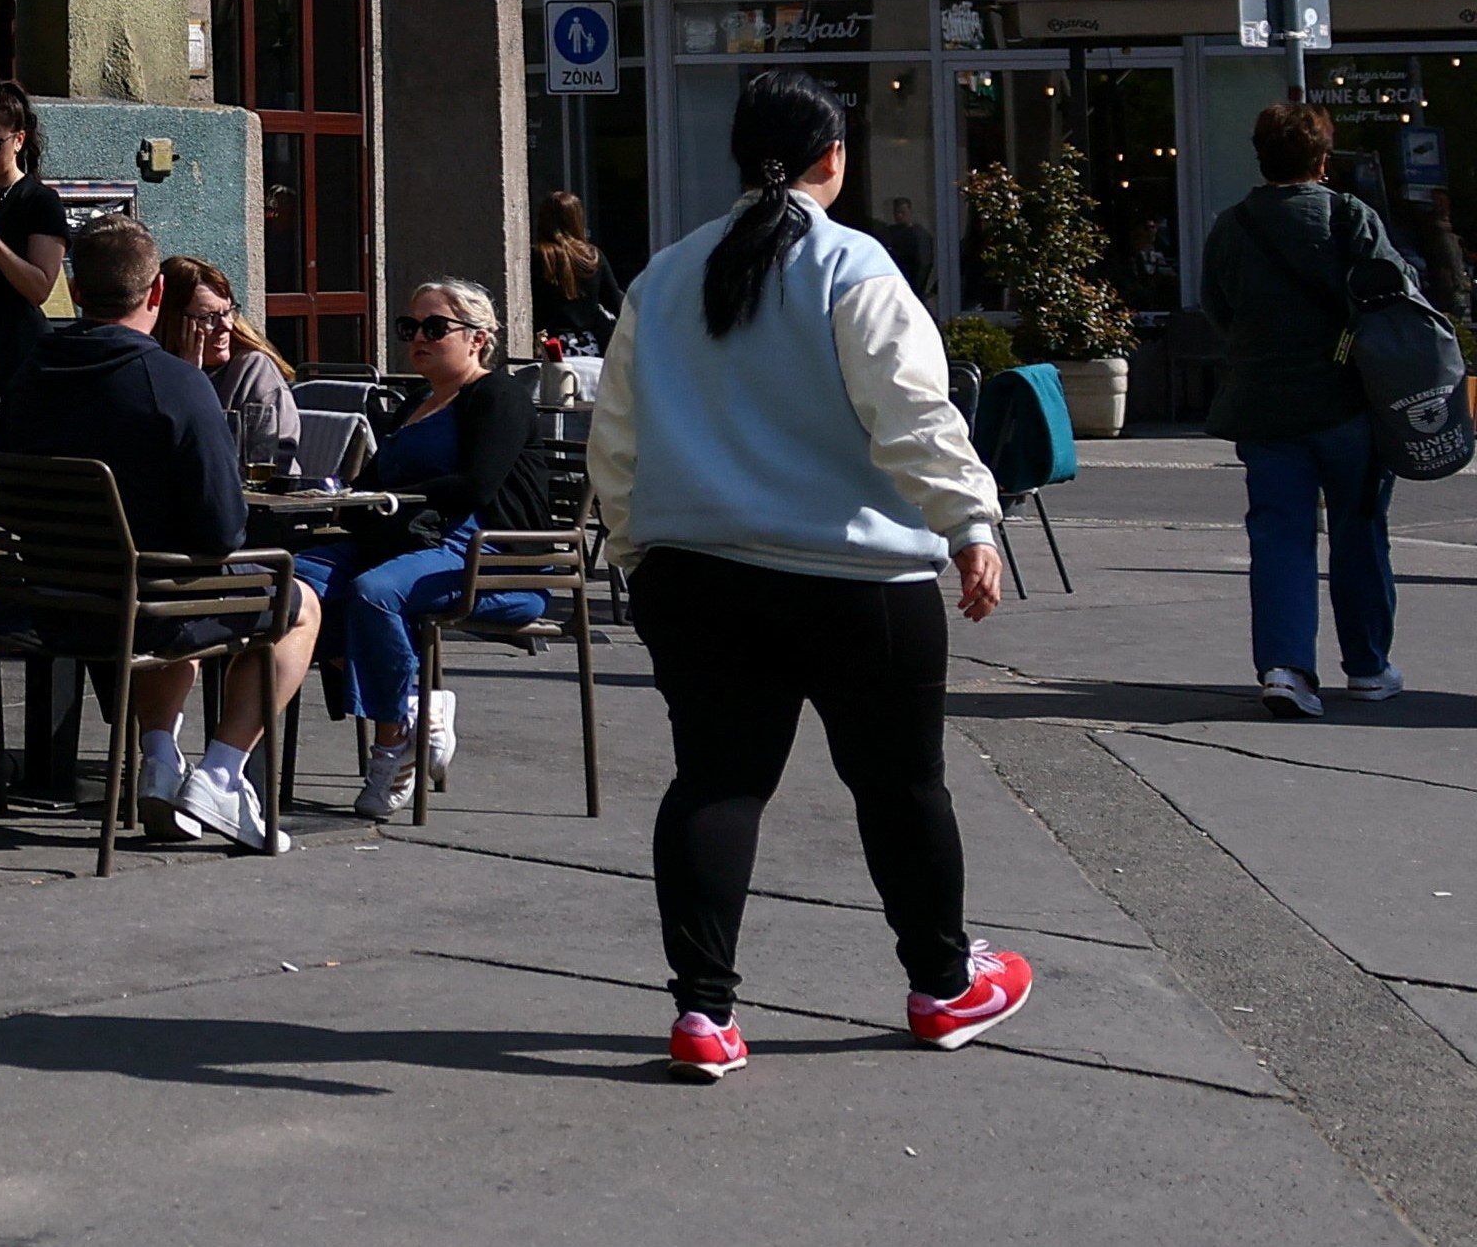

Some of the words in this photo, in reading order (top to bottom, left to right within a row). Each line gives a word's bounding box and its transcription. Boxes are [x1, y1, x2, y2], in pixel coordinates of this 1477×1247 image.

[561, 65, 604, 86] ZÓNA
[1309, 89, 1353, 104] WINE
[1356, 89, 1372, 104] &
